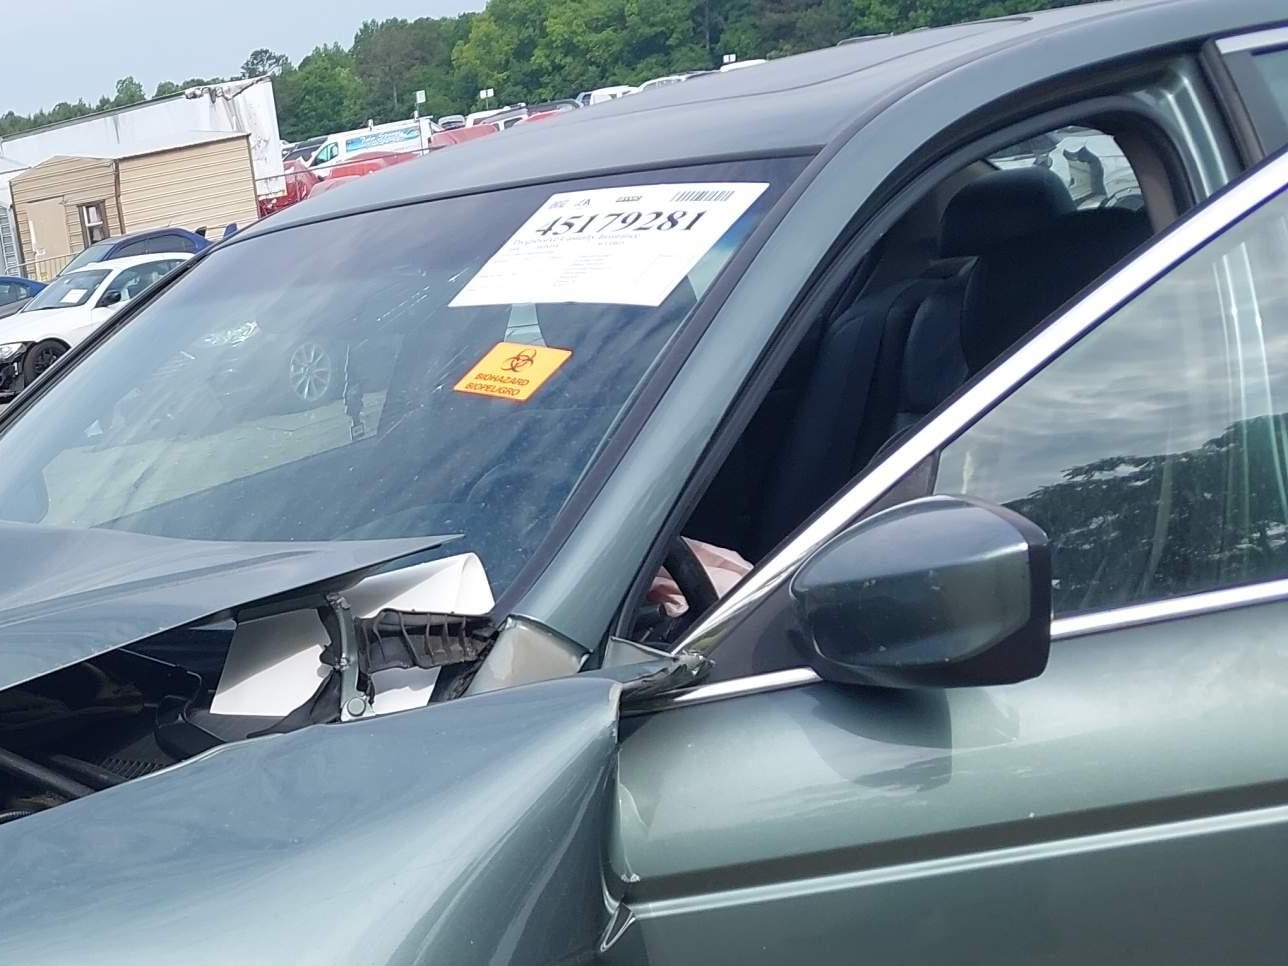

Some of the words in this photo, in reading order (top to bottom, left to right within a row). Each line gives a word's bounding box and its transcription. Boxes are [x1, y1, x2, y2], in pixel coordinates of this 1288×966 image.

[536, 209, 707, 236] 45179281
[475, 372, 530, 386] BIOHAZARD
[465, 382, 521, 397] BIOPELIGRO
